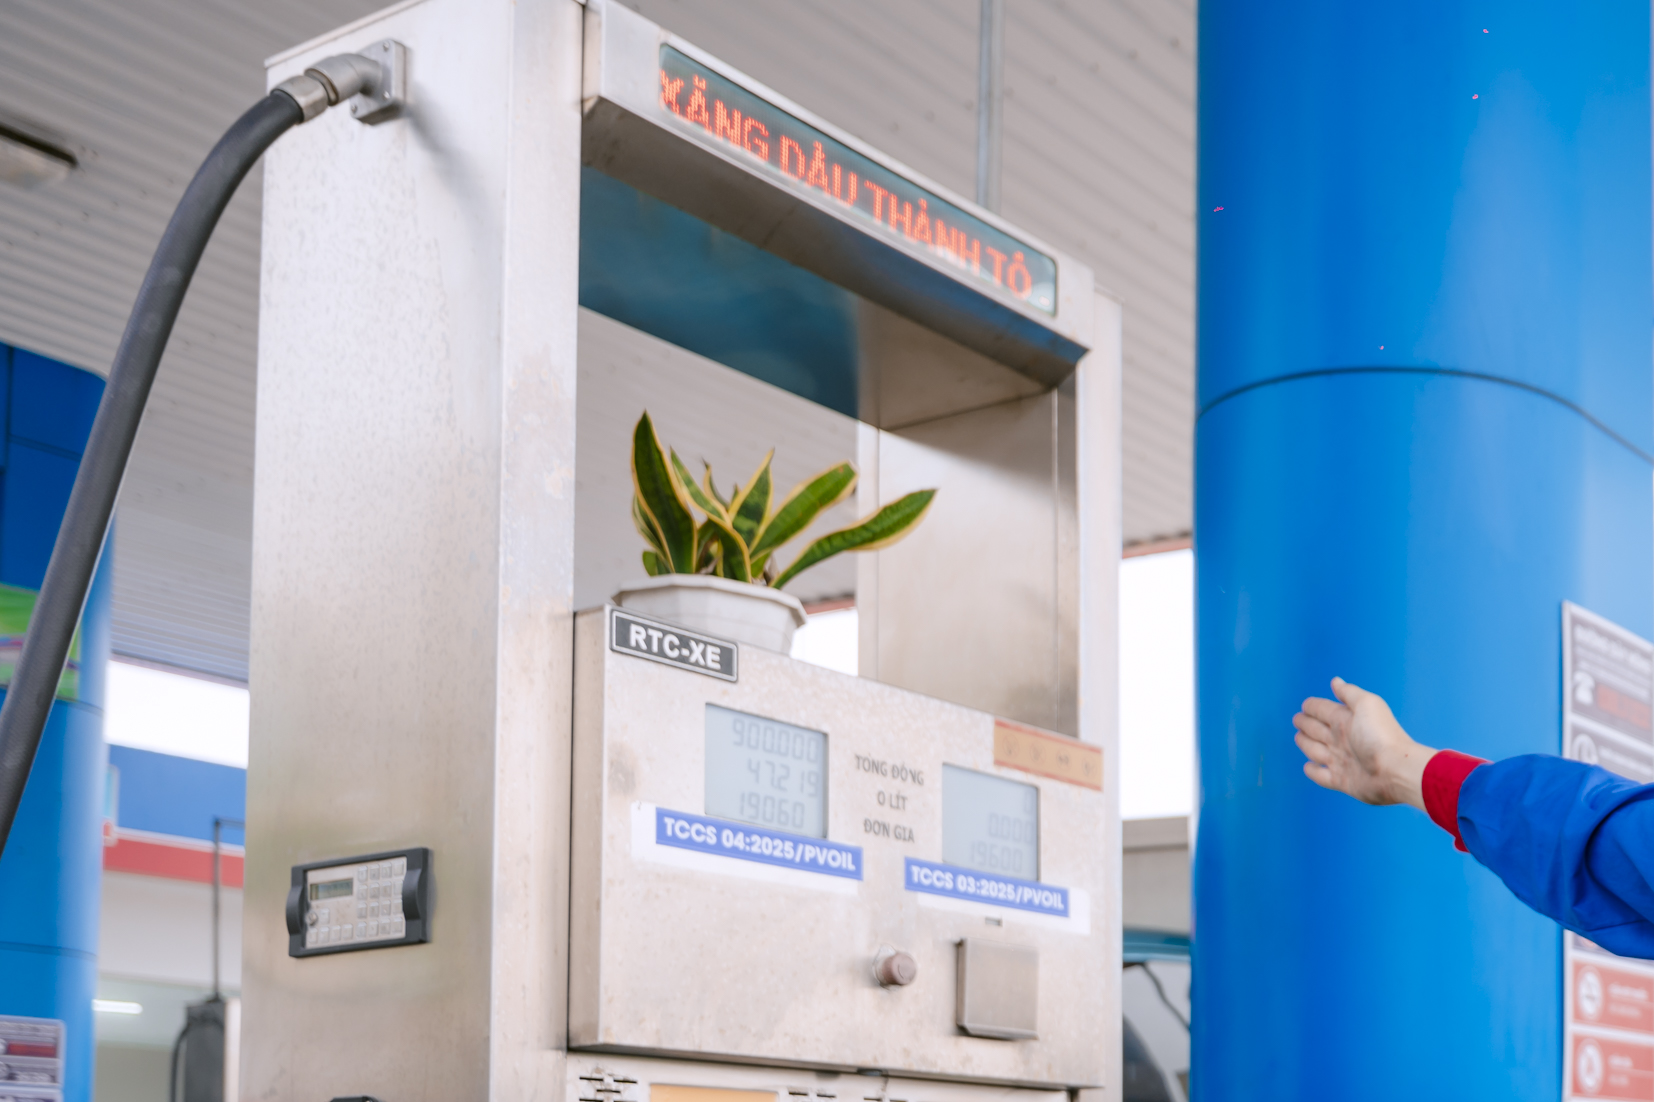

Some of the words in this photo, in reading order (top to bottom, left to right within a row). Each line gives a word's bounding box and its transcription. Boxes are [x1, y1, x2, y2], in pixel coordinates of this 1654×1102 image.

[629, 623, 722, 671] RTC-XE
[664, 816, 717, 845] TCCS
[722, 829, 856, 871] 04:2025/PVOIL
[911, 865, 954, 890] TCCS
[957, 874, 1064, 910] 03:2025/PVOIL
